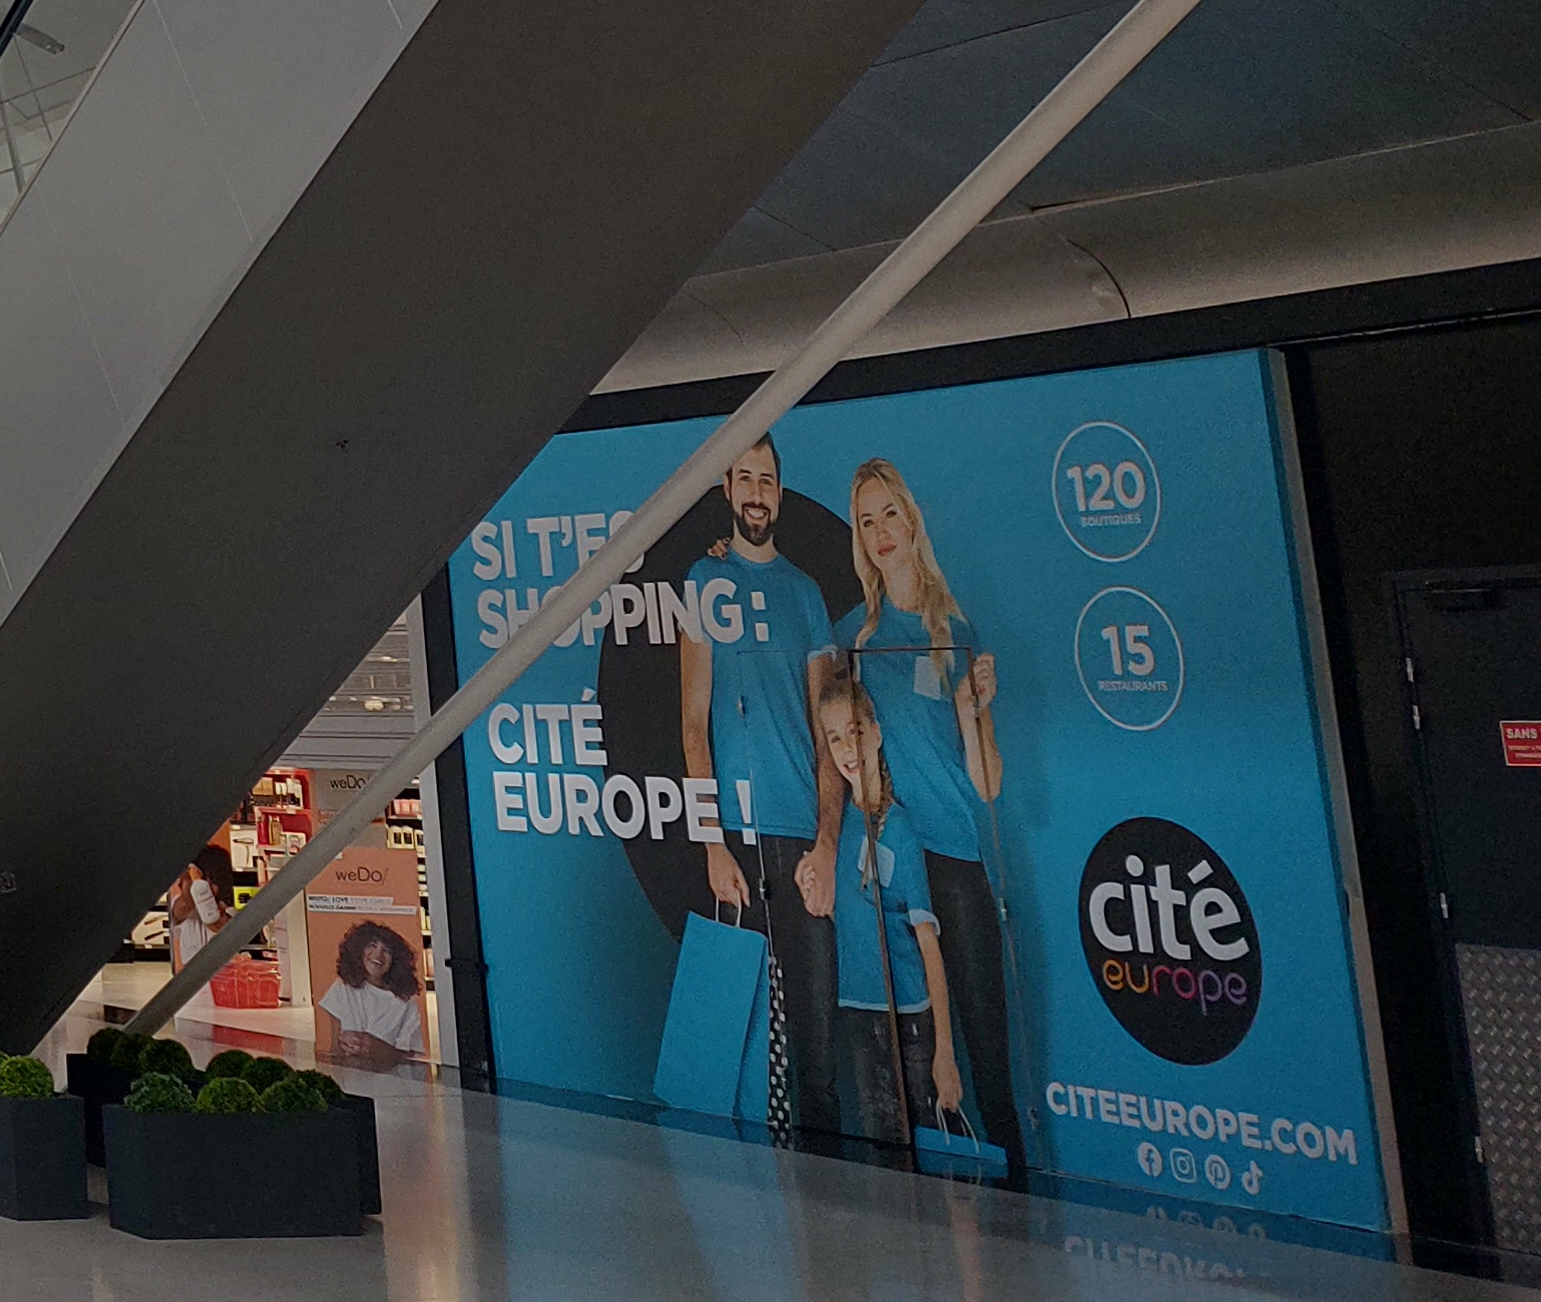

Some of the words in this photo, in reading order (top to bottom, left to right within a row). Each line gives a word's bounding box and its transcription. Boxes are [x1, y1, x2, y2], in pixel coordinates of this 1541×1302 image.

[1067, 461, 1146, 512] 120
[1080, 512, 1142, 528] BOUTIQUES
[470, 520, 517, 581] SI
[1101, 624, 1156, 677] 15
[1098, 679, 1168, 692] RESTAURANTS
[488, 688, 608, 766] CITÉ
[1506, 728, 1538, 740] SANS
[493, 771, 724, 844] EUROPE
[1088, 854, 1251, 962] cité
[1102, 959, 1248, 1016] europe
[1045, 1081, 1359, 1166] CITEEUROPE.COM
